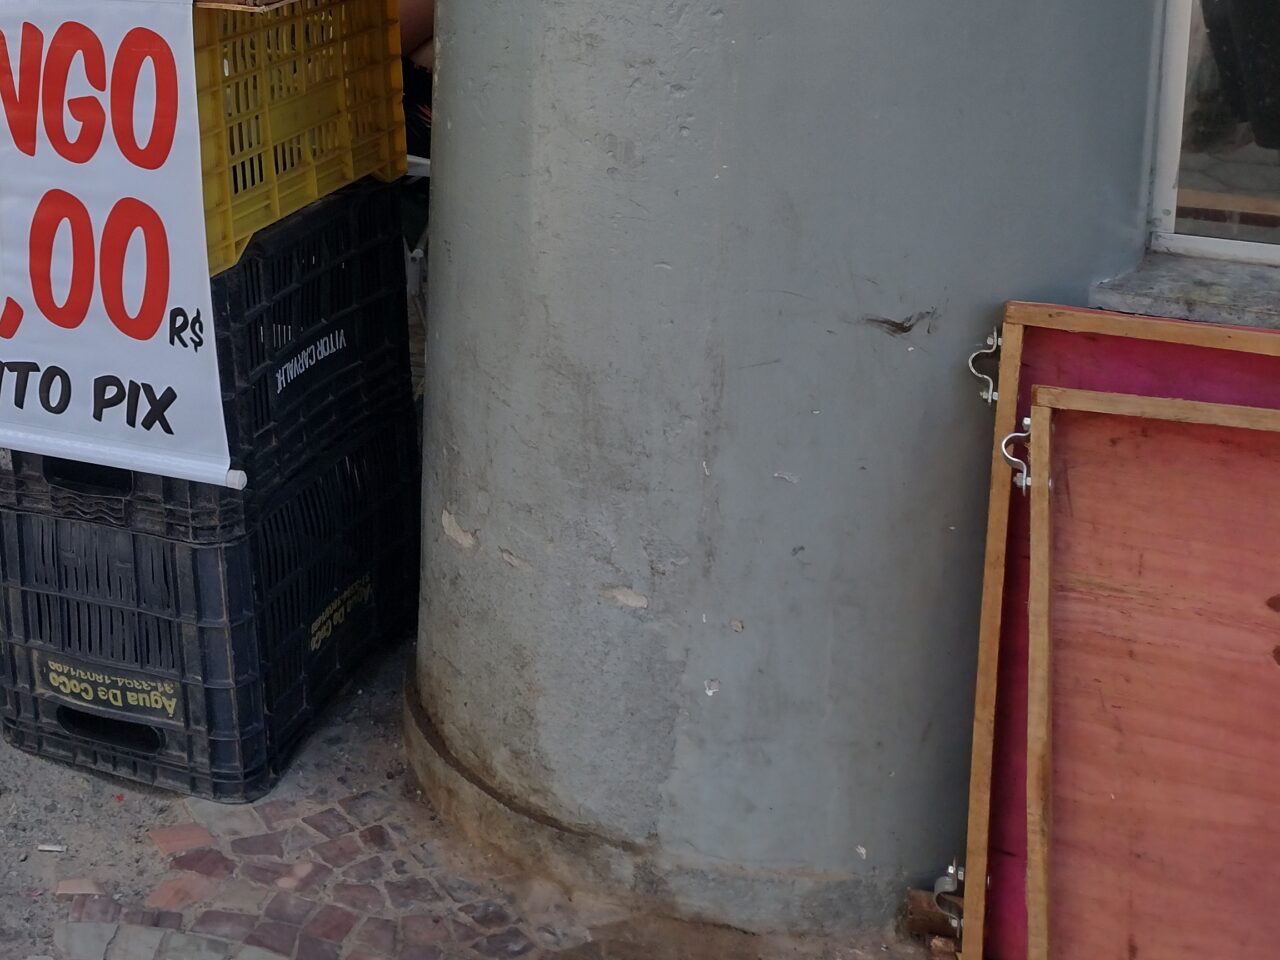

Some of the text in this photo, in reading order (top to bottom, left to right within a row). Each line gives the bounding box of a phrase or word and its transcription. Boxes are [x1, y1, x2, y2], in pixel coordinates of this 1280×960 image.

[169, 306, 205, 353] R$
[276, 328, 347, 395] VITOR CARVALH
[92, 374, 178, 436] PIX
